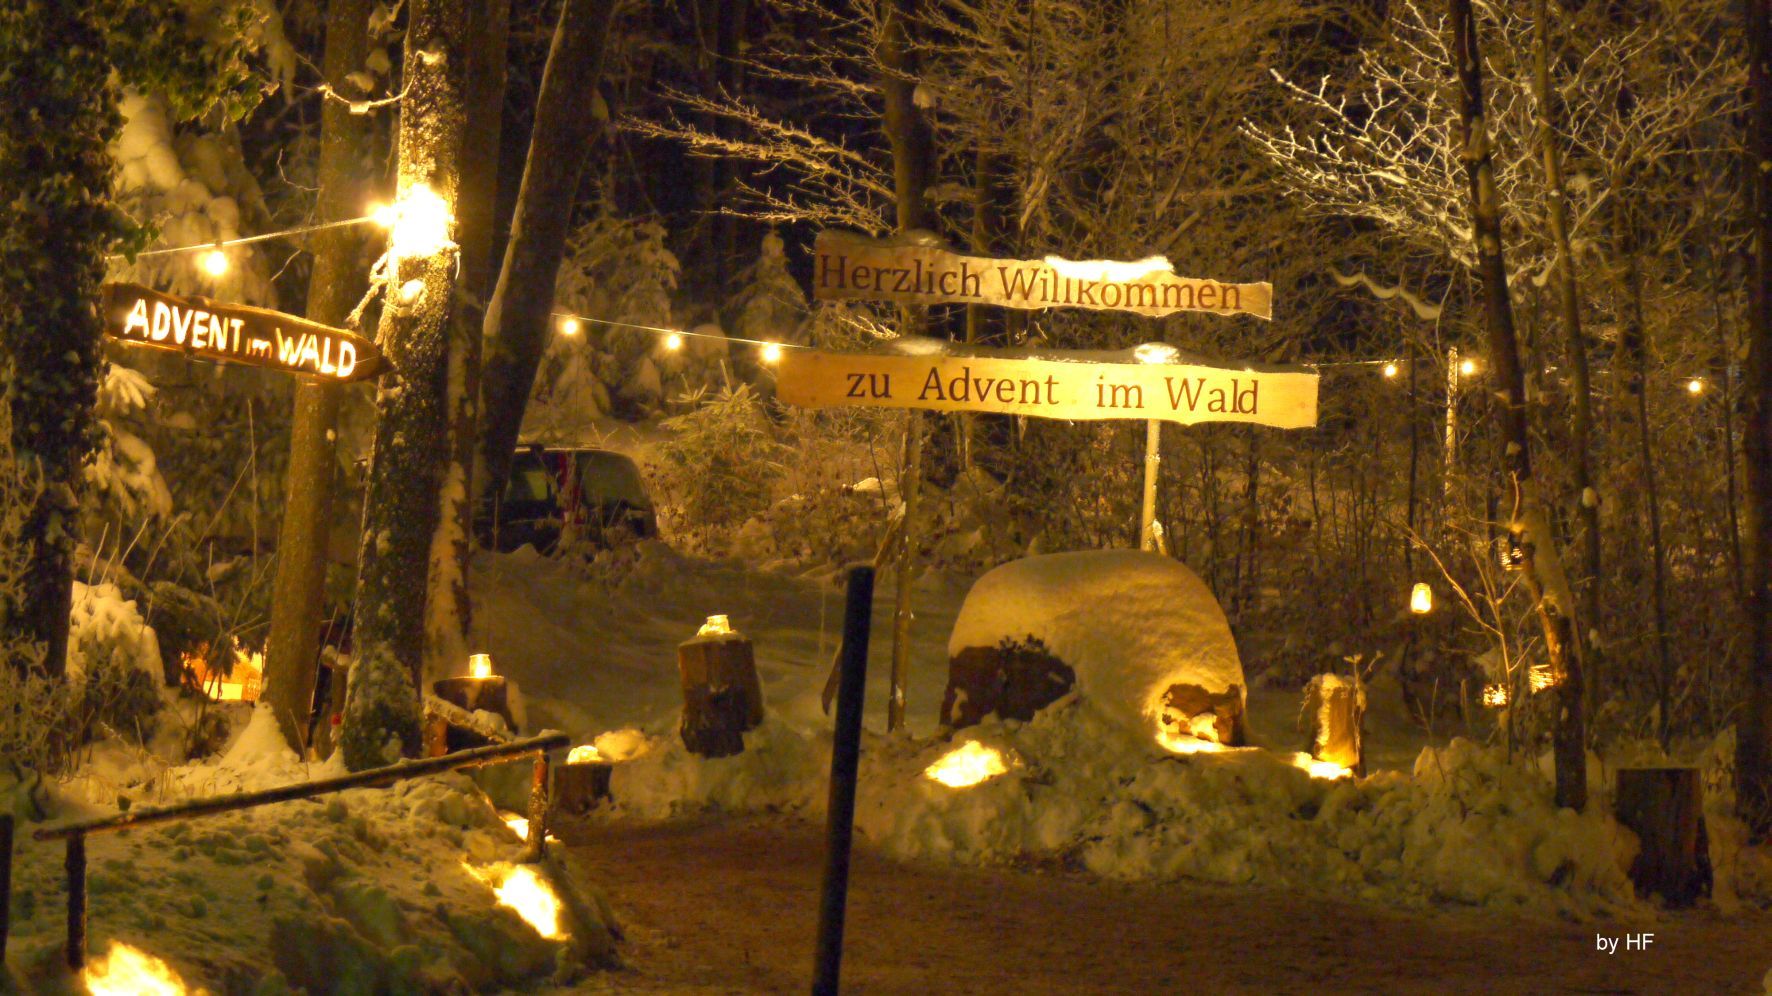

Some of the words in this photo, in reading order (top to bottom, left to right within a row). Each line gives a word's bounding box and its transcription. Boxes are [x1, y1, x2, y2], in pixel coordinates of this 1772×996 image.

[820, 254, 982, 298] Herzlich
[997, 266, 1242, 310] Willkommen
[123, 298, 245, 353] ADVENT
[275, 327, 357, 377] WALD
[847, 372, 890, 398] zu
[919, 366, 1059, 406] Advent
[1096, 375, 1143, 409] im
[1167, 377, 1259, 415] Wald
